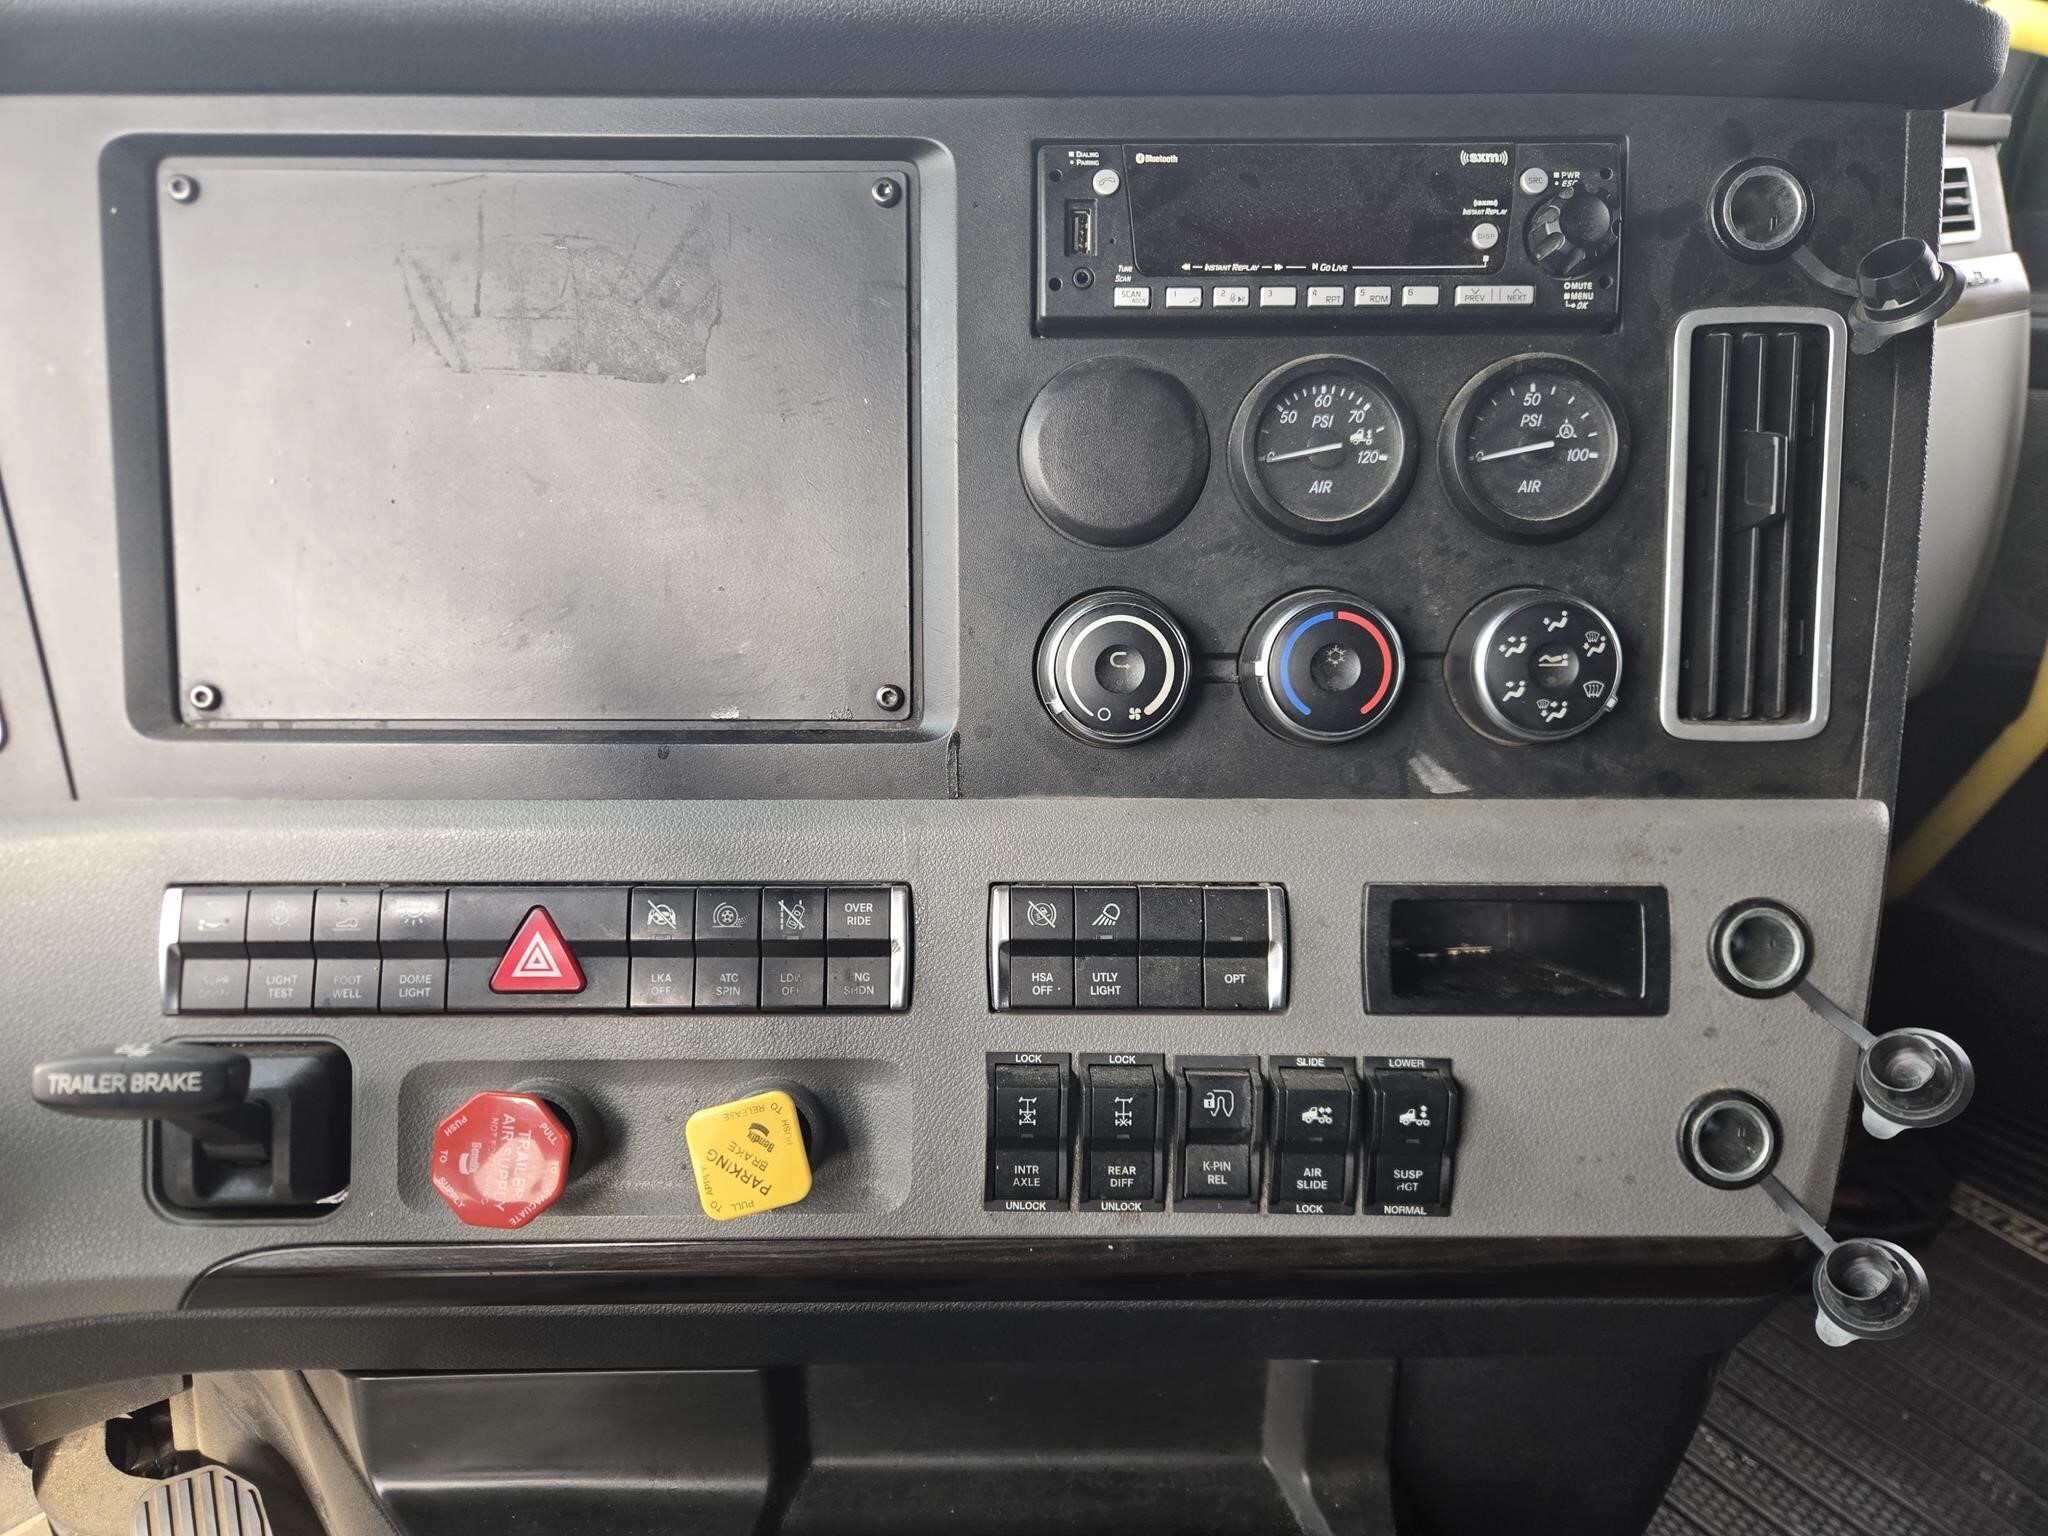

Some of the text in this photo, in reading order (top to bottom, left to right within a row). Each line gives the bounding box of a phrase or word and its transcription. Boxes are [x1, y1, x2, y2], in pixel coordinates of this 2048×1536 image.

[1145, 154, 1178, 164] Bluetooth
[1561, 171, 1580, 179] PWR
[1528, 177, 1543, 185] SRC
[1204, 263, 1260, 272] INSTANT REPLAY
[1570, 281, 1593, 290] MUTE
[1121, 290, 1142, 298] SCAN
[1267, 289, 1273, 297] 3
[1464, 294, 1486, 302] PREV
[1506, 293, 1527, 302] NEXT
[1570, 291, 1594, 300] MENU
[1325, 295, 1341, 304] RPT
[1576, 302, 1588, 310] OK
[1314, 394, 1333, 408] 60
[1523, 392, 1542, 407] 50
[1279, 410, 1298, 424] 50
[1312, 415, 1334, 429] PSI
[1347, 410, 1366, 424] 70
[1520, 413, 1543, 427] PSI
[1357, 450, 1379, 464] 120
[1567, 448, 1589, 462] 100
[1308, 479, 1334, 494] AIR
[1517, 479, 1542, 493] AIR
[844, 903, 874, 913] OVER
[847, 915, 872, 926] RIDE
[266, 974, 298, 985] LIGHT
[333, 975, 362, 985] FOOT
[399, 974, 432, 985] DOME
[651, 973, 672, 983] LKA
[719, 972, 738, 983] ATC
[852, 972, 871, 982] NG
[1031, 972, 1054, 982] HSA
[1092, 972, 1118, 982] UTLY
[1224, 974, 1245, 984] OPT
[268, 988, 294, 999] TEST
[332, 988, 362, 999] WELL
[399, 987, 432, 998] LIGHT
[650, 986, 671, 996] OFF
[716, 986, 740, 996] SPIN
[1032, 985, 1053, 996] OFF
[1090, 985, 1121, 996] LIGHT
[1015, 1054, 1042, 1064] LOCK
[1109, 1055, 1136, 1065] LOCK
[1296, 1057, 1325, 1067] SLIDE
[1388, 1058, 1425, 1068] LOWER
[48, 1071, 203, 1096] TRAILER BRAKE
[722, 1103, 766, 1121] RELEASE
[770, 1102, 783, 1114] TO
[746, 1128, 776, 1153] Bendix
[727, 1140, 769, 1172] BRAKE
[438, 1115, 468, 1209] PUSH TO SUPPLY
[494, 1113, 516, 1213] AIR SUPPLY
[511, 1130, 532, 1200] TRAILER
[1202, 1161, 1232, 1172] K-PIN
[508, 1122, 560, 1226] PULL TO EVACUATE
[705, 1148, 773, 1196] PARKING
[1014, 1165, 1039, 1175] INTR
[1107, 1166, 1137, 1176] REAR
[1303, 1168, 1322, 1178] AIR
[1393, 1169, 1424, 1180] SUSP
[1012, 1177, 1041, 1187] AXLE
[1110, 1178, 1134, 1188] DIFF
[1207, 1174, 1228, 1185] REL
[1296, 1180, 1329, 1190] SLIDE
[701, 1166, 755, 1213] PULL TO APPLY
[1005, 1201, 1047, 1211] UNLOCK
[1100, 1201, 1142, 1212] UNLOCK
[1296, 1204, 1324, 1214] LOCK
[1384, 1205, 1428, 1216] NORMAL
